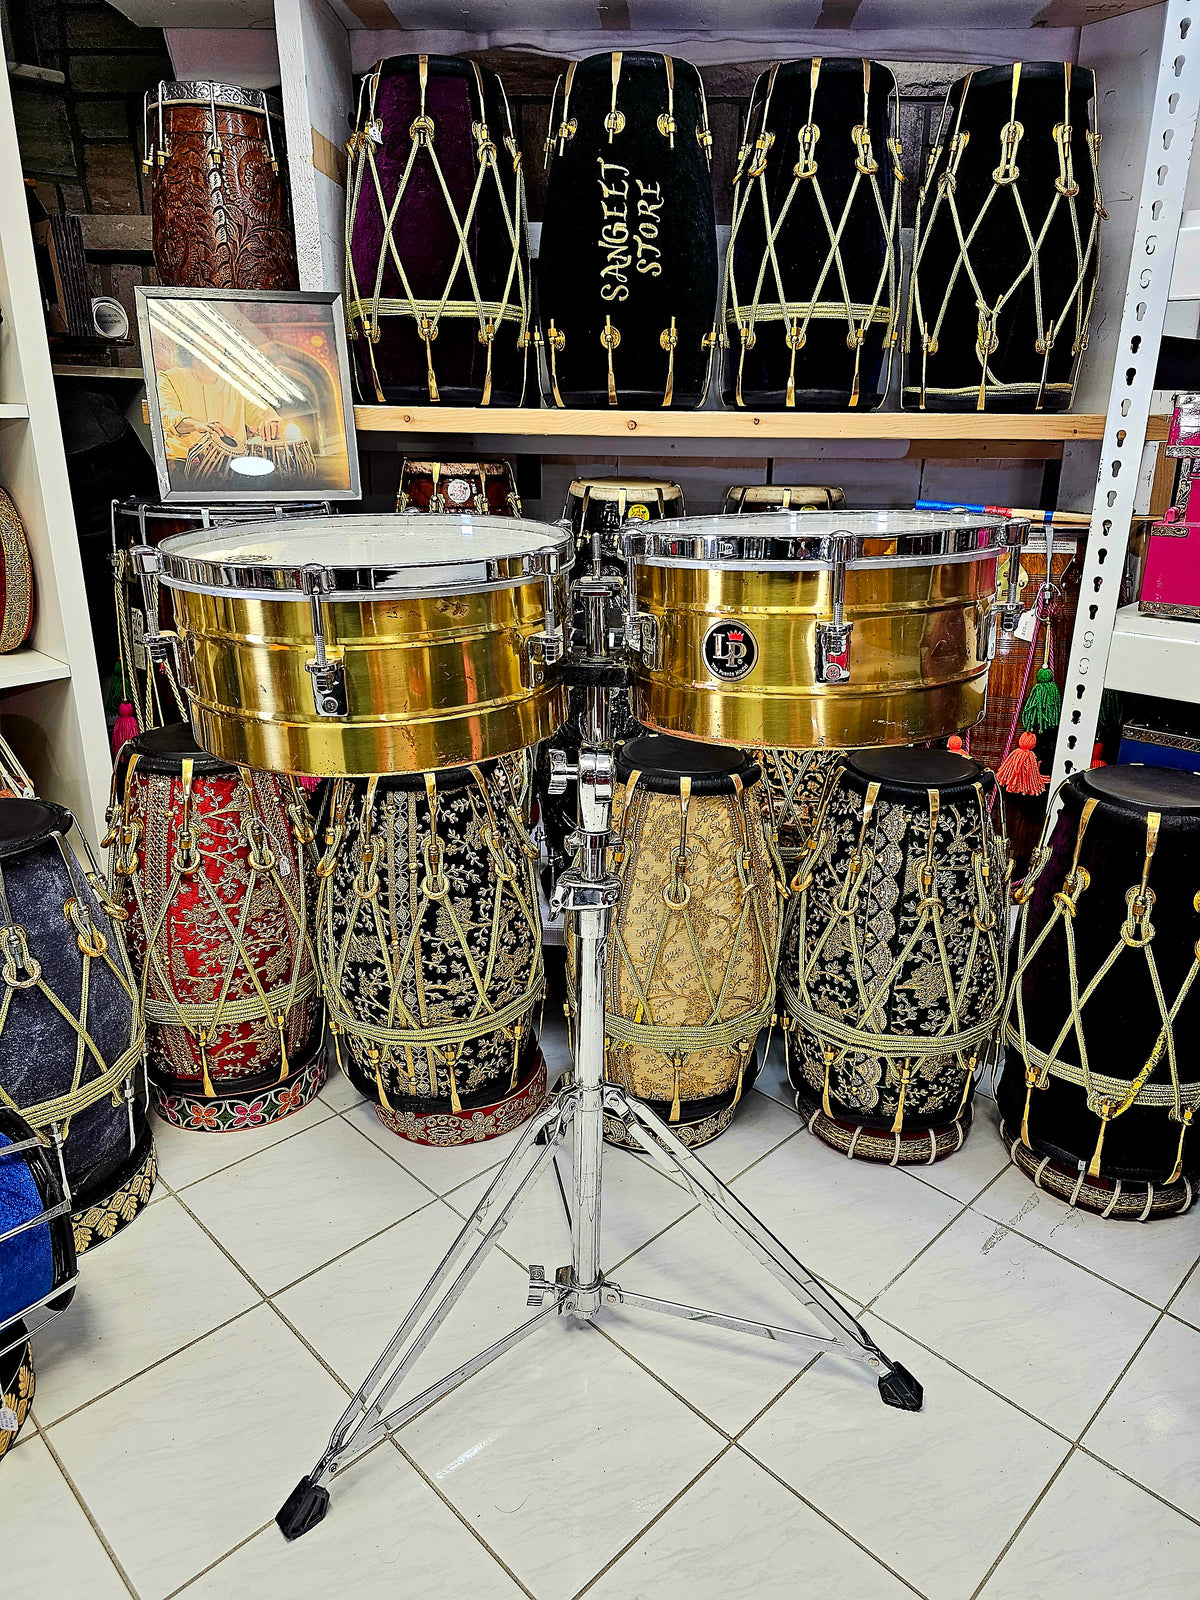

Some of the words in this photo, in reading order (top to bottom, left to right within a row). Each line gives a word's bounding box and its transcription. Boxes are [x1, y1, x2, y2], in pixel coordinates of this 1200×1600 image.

[597, 157, 632, 301] SANGEET
[633, 179, 664, 277] STORE
[713, 633, 747, 667] LP
